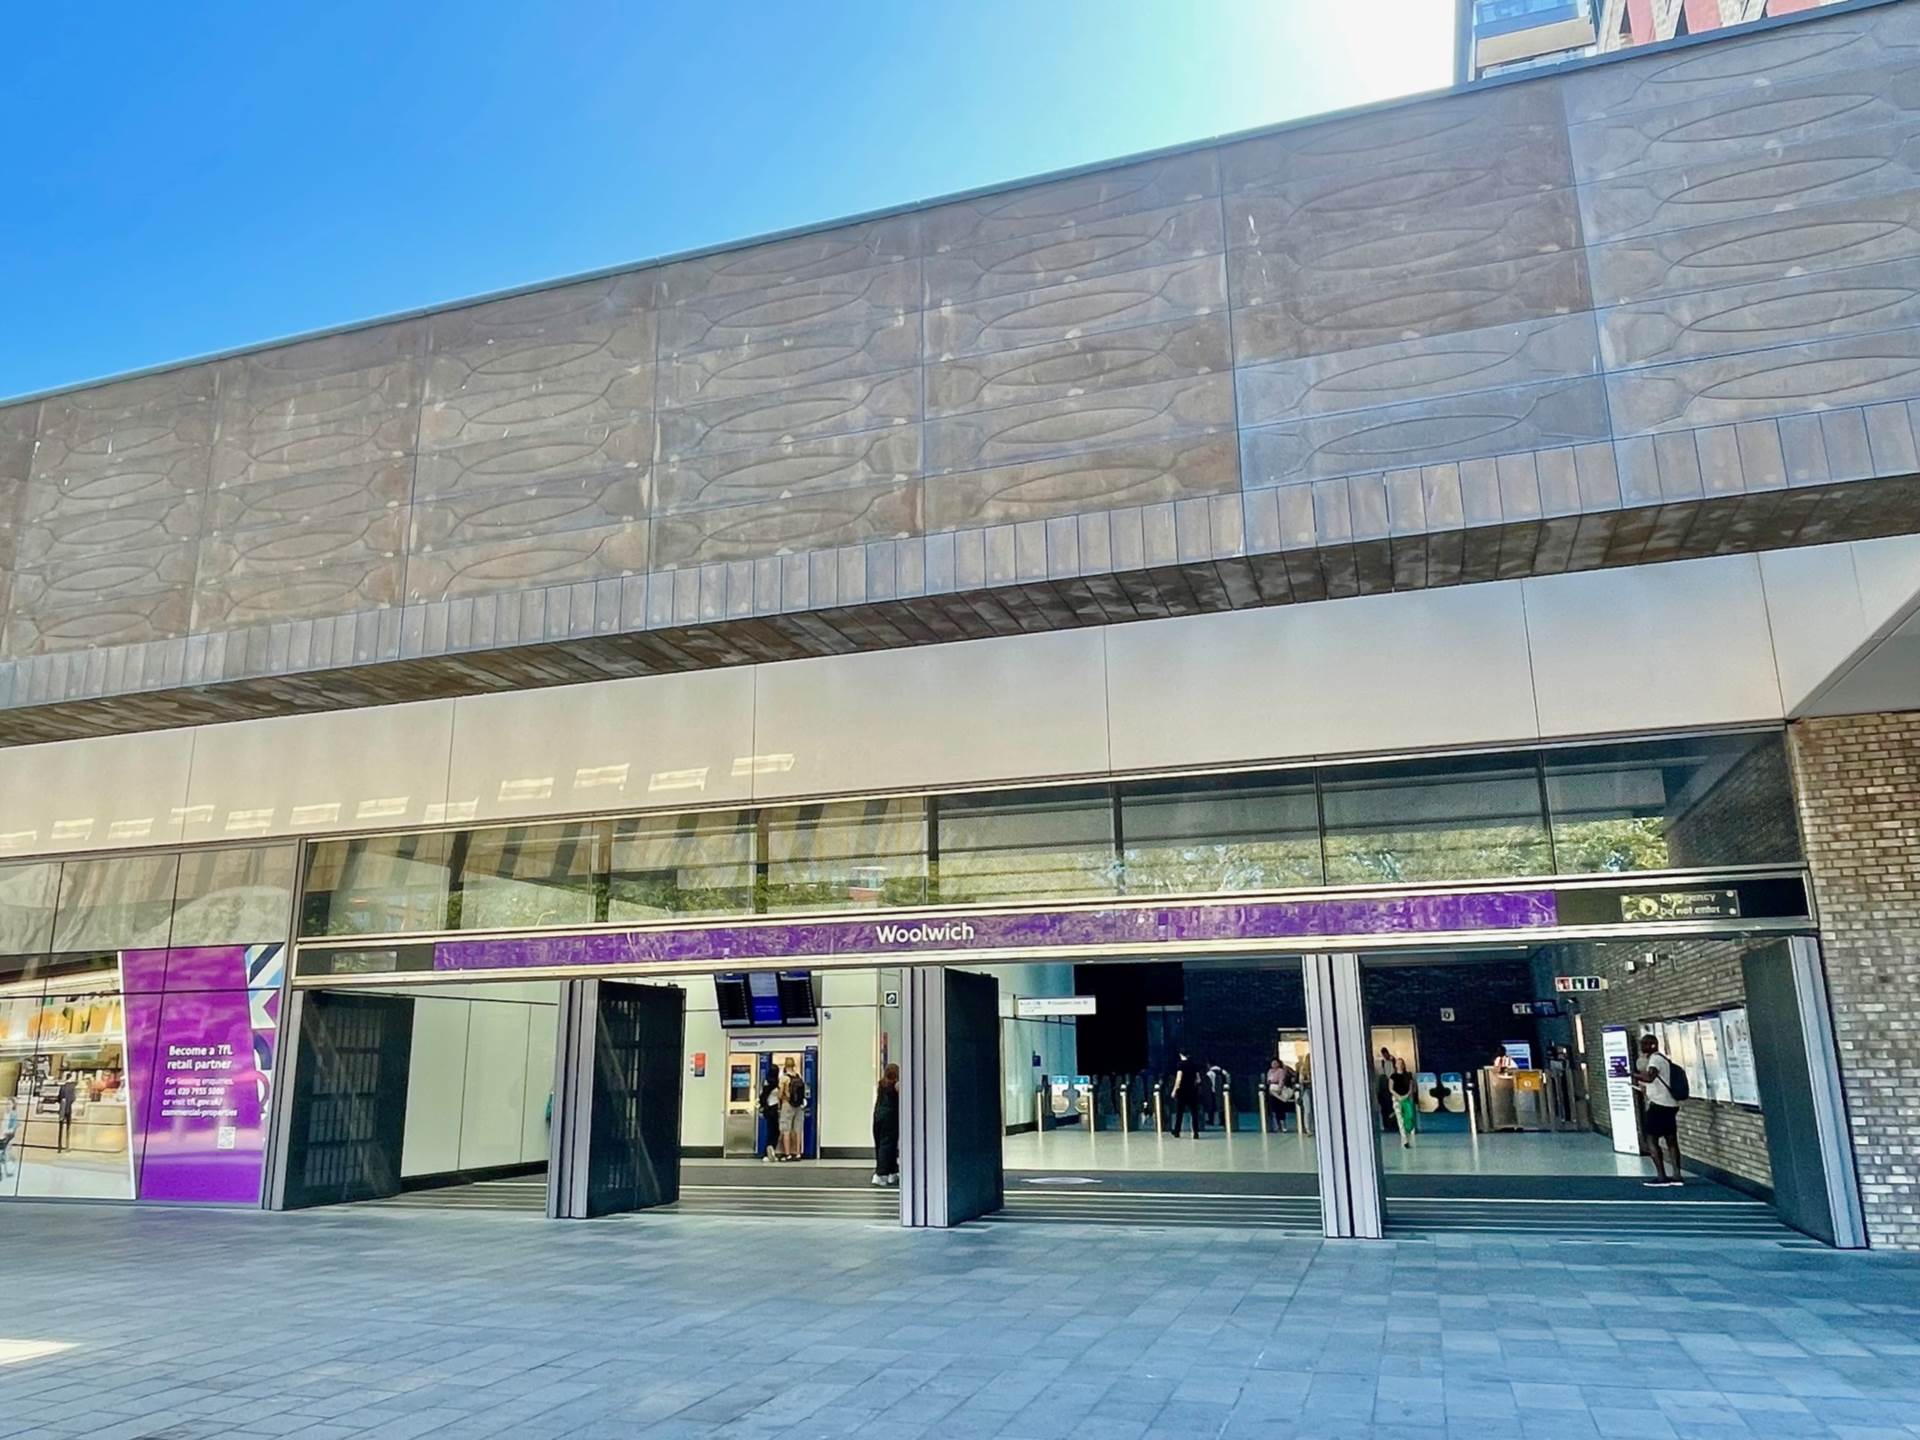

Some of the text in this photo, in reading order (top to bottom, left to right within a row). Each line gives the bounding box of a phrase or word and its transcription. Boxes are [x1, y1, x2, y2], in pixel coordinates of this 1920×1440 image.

[1676, 906, 1693, 915] not
[875, 922, 974, 943] Woolwich
[169, 1044, 233, 1056] Become a TfL
[167, 1059, 232, 1071] retail partner
[164, 1077, 176, 1085] For
[164, 1087, 177, 1096] call
[177, 1087, 190, 1096] 020
